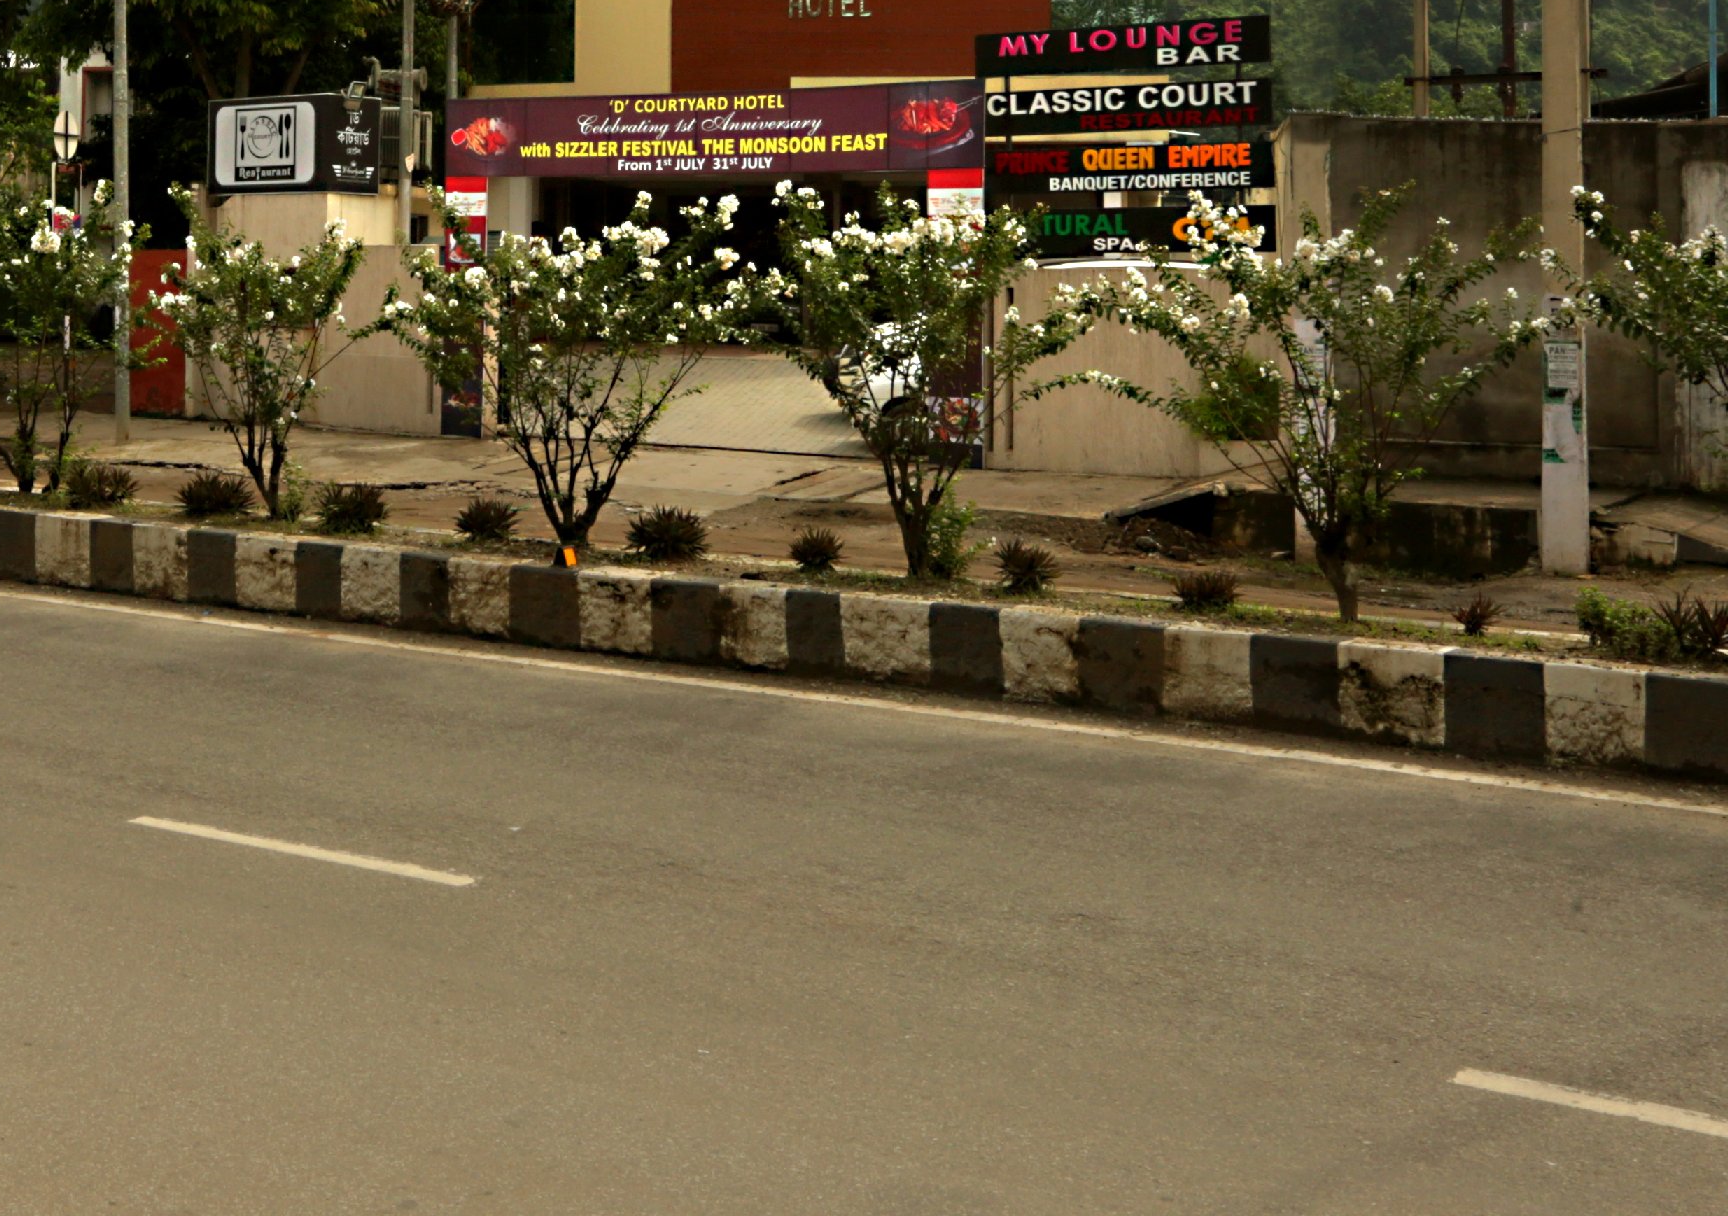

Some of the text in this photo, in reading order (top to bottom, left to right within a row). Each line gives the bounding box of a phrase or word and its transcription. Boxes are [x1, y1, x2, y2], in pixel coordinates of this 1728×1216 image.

[998, 20, 1243, 57] MY LOUNGE
[1156, 44, 1241, 65] BAR
[634, 97, 729, 113] COURTYARD
[734, 95, 785, 110] HOTEL
[986, 81, 1258, 116] CLASSIC COURT
[577, 114, 669, 140] Celebrating
[701, 111, 823, 136] Anniversary
[1079, 107, 1260, 130] RESTAURANT
[520, 133, 888, 158] with SIZZLER FESTIVAL THE MONSOON FEAST
[617, 156, 773, 171] From 1st JULY 31st JULY
[995, 143, 1252, 174] PRINCE QUEEN EMPIRE
[238, 166, 292, 180] Restaurant
[1049, 171, 1251, 192] BANQUET/CONFERENCE
[1043, 213, 1128, 235] TURAL
[1093, 237, 1136, 252] SPA
